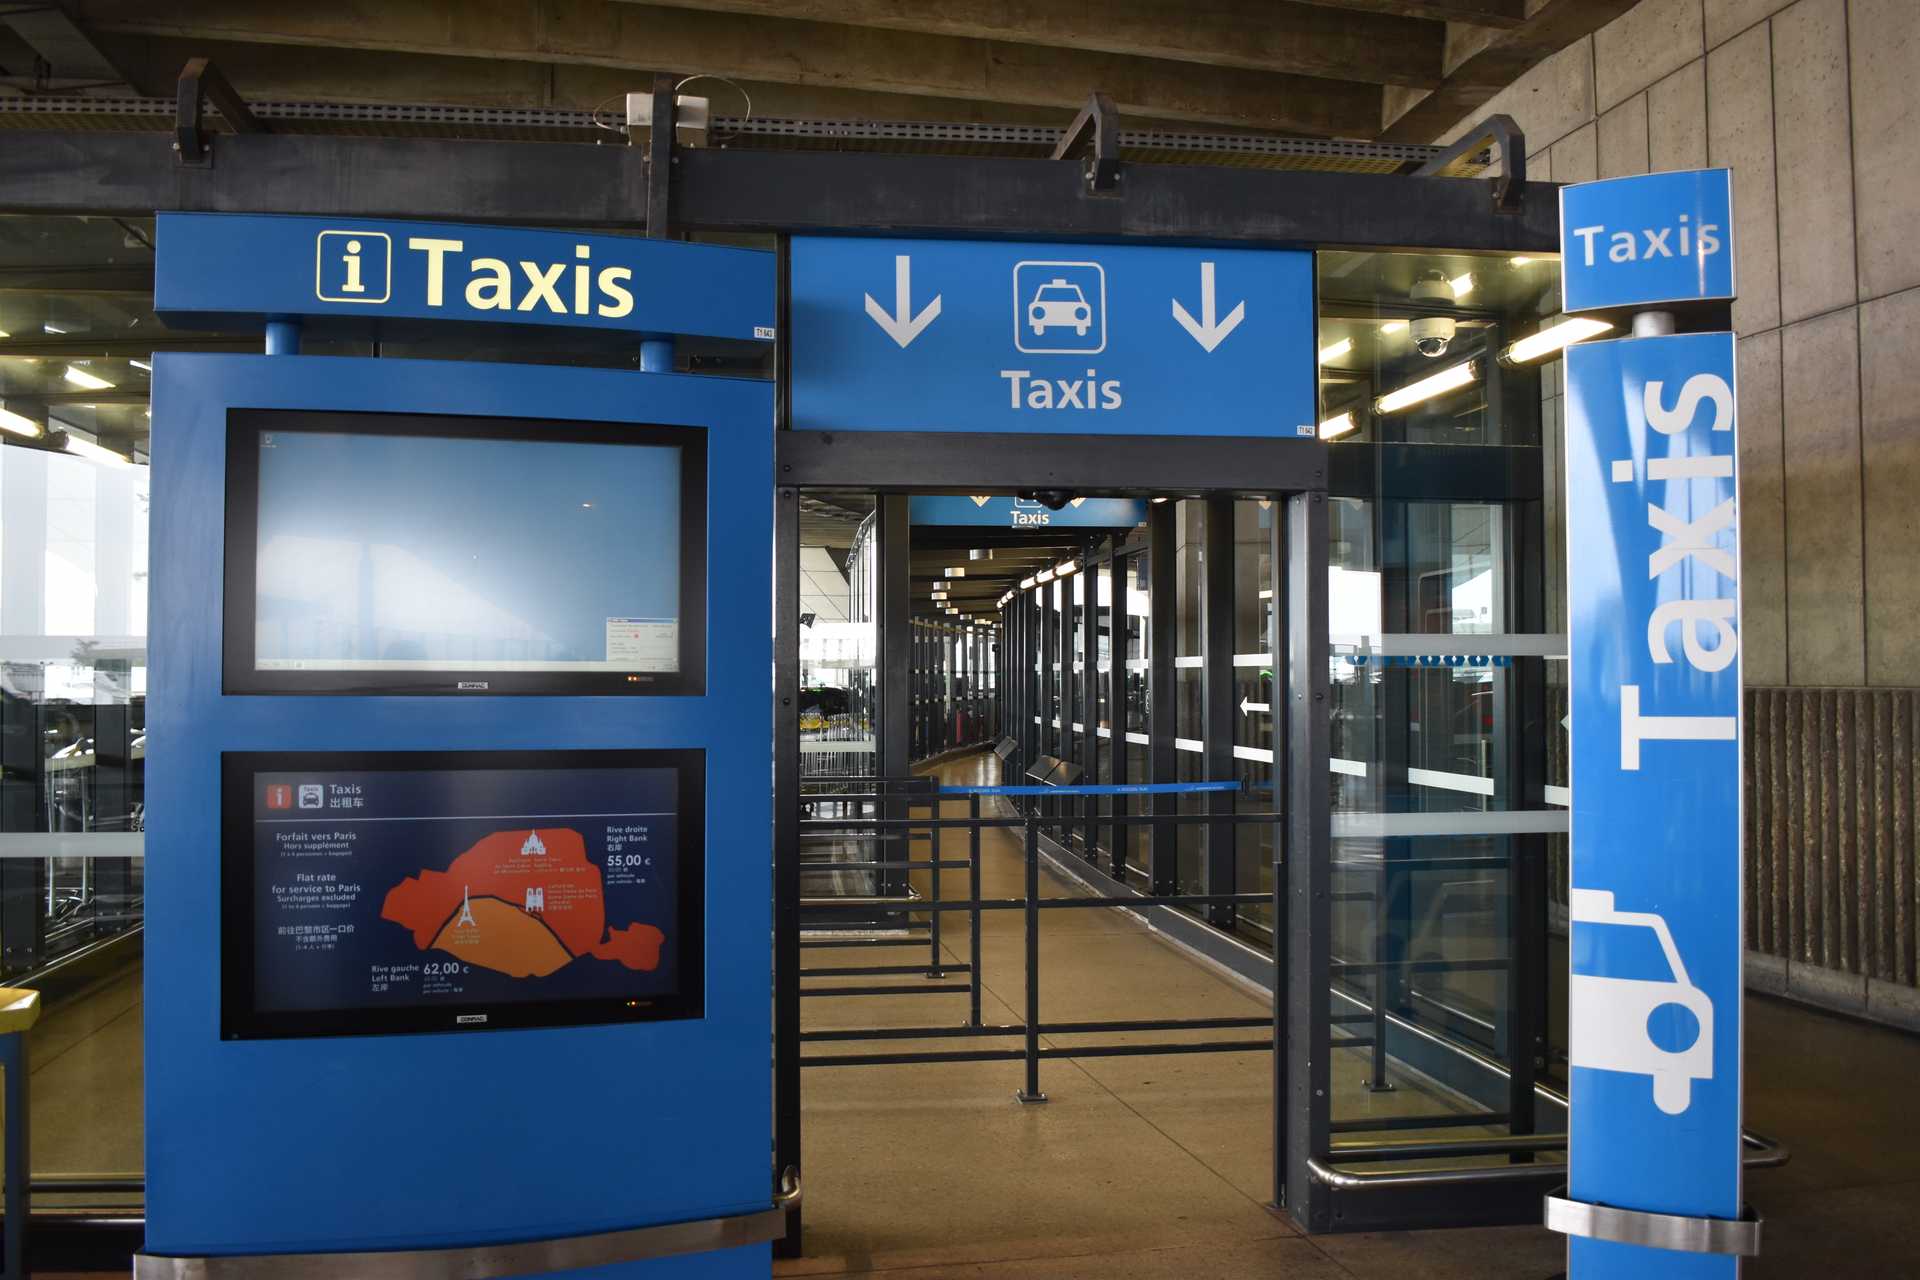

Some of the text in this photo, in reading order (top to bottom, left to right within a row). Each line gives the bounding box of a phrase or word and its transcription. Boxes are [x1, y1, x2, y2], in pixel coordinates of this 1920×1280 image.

[1573, 214, 1720, 266] Taxis
[408, 237, 635, 319] Taxis
[1000, 368, 1122, 410] Taxis
[1010, 510, 1049, 525] Taxis
[1612, 373, 1737, 770] Taxis
[329, 784, 361, 794] Taxis
[329, 797, 364, 809] 出租车
[276, 831, 357, 841] Forfait vers Paris
[607, 834, 648, 843] Right Bank
[607, 855, 641, 867] 55,00
[297, 873, 336, 882] Flat rate
[271, 883, 361, 894] for service to Paris
[276, 893, 356, 903] Surcharges excluded
[371, 964, 420, 974] Rive gauche
[423, 962, 459, 975] 62,00
[371, 974, 409, 982] Left Bank
